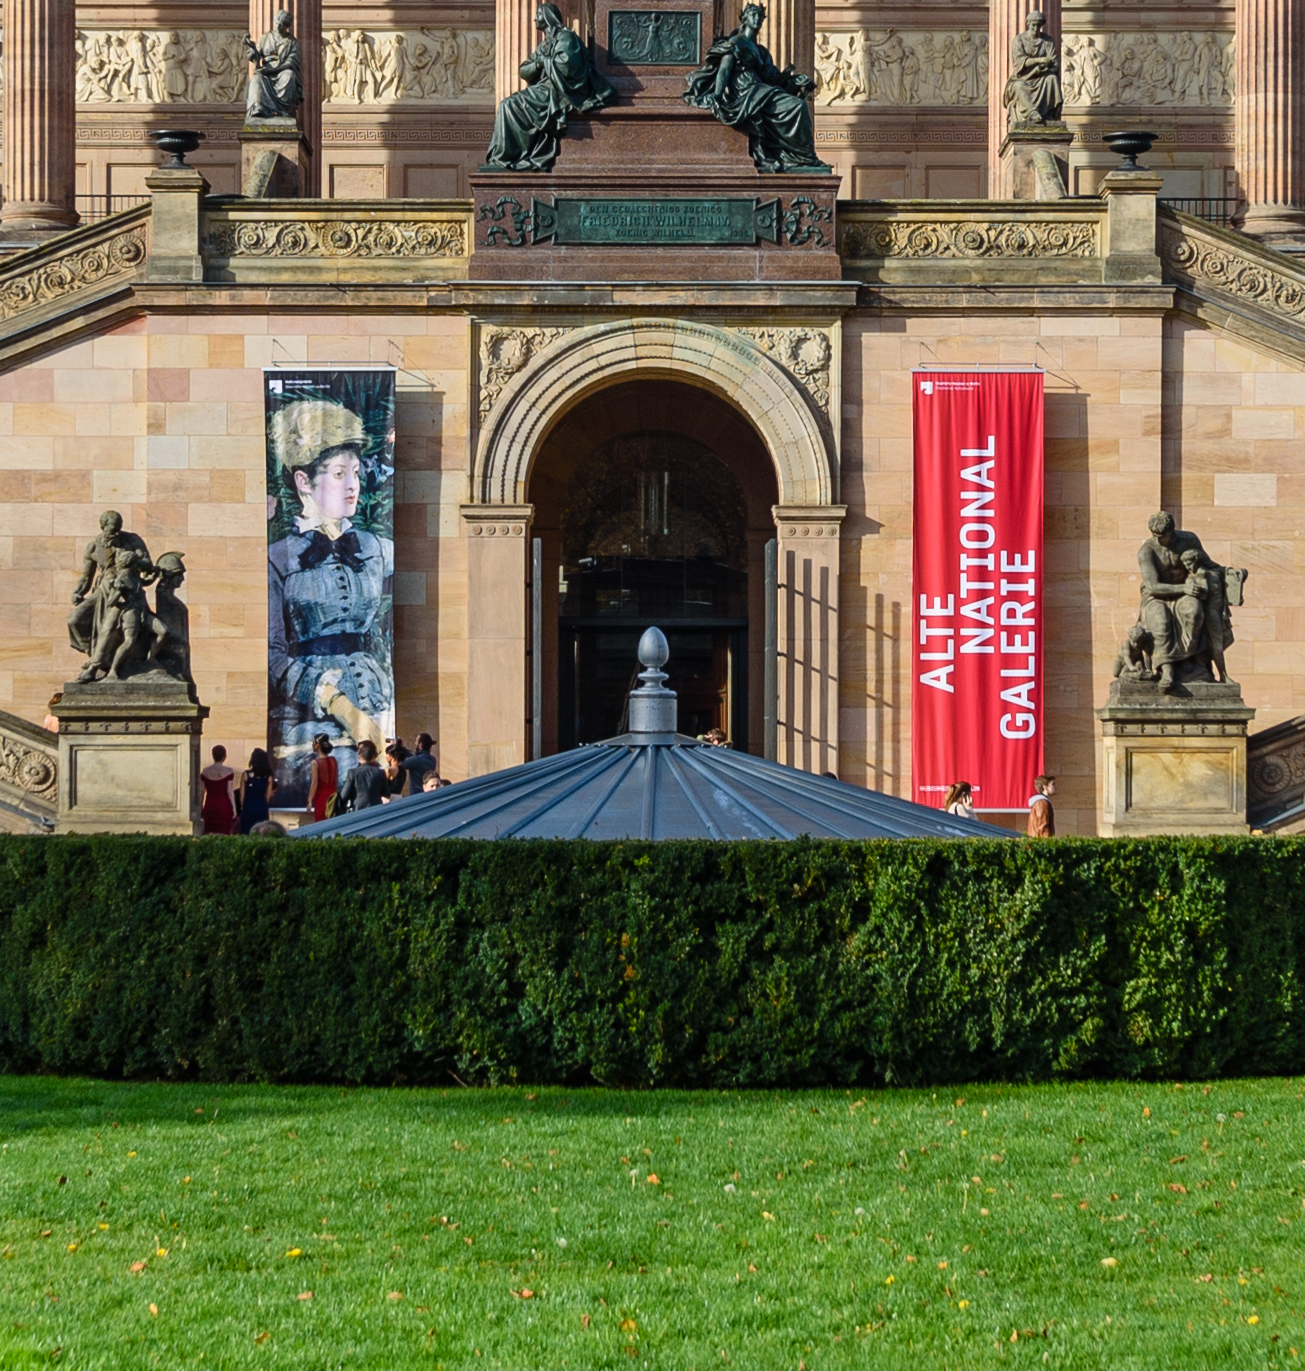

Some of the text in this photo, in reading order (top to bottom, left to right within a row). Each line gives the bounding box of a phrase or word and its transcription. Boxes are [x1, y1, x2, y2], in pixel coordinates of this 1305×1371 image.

[582, 215, 651, 227] FRIEDRICH
[959, 435, 996, 654] NATIONAL
[919, 593, 955, 693] ALTE
[999, 549, 1036, 740] GALERIE
